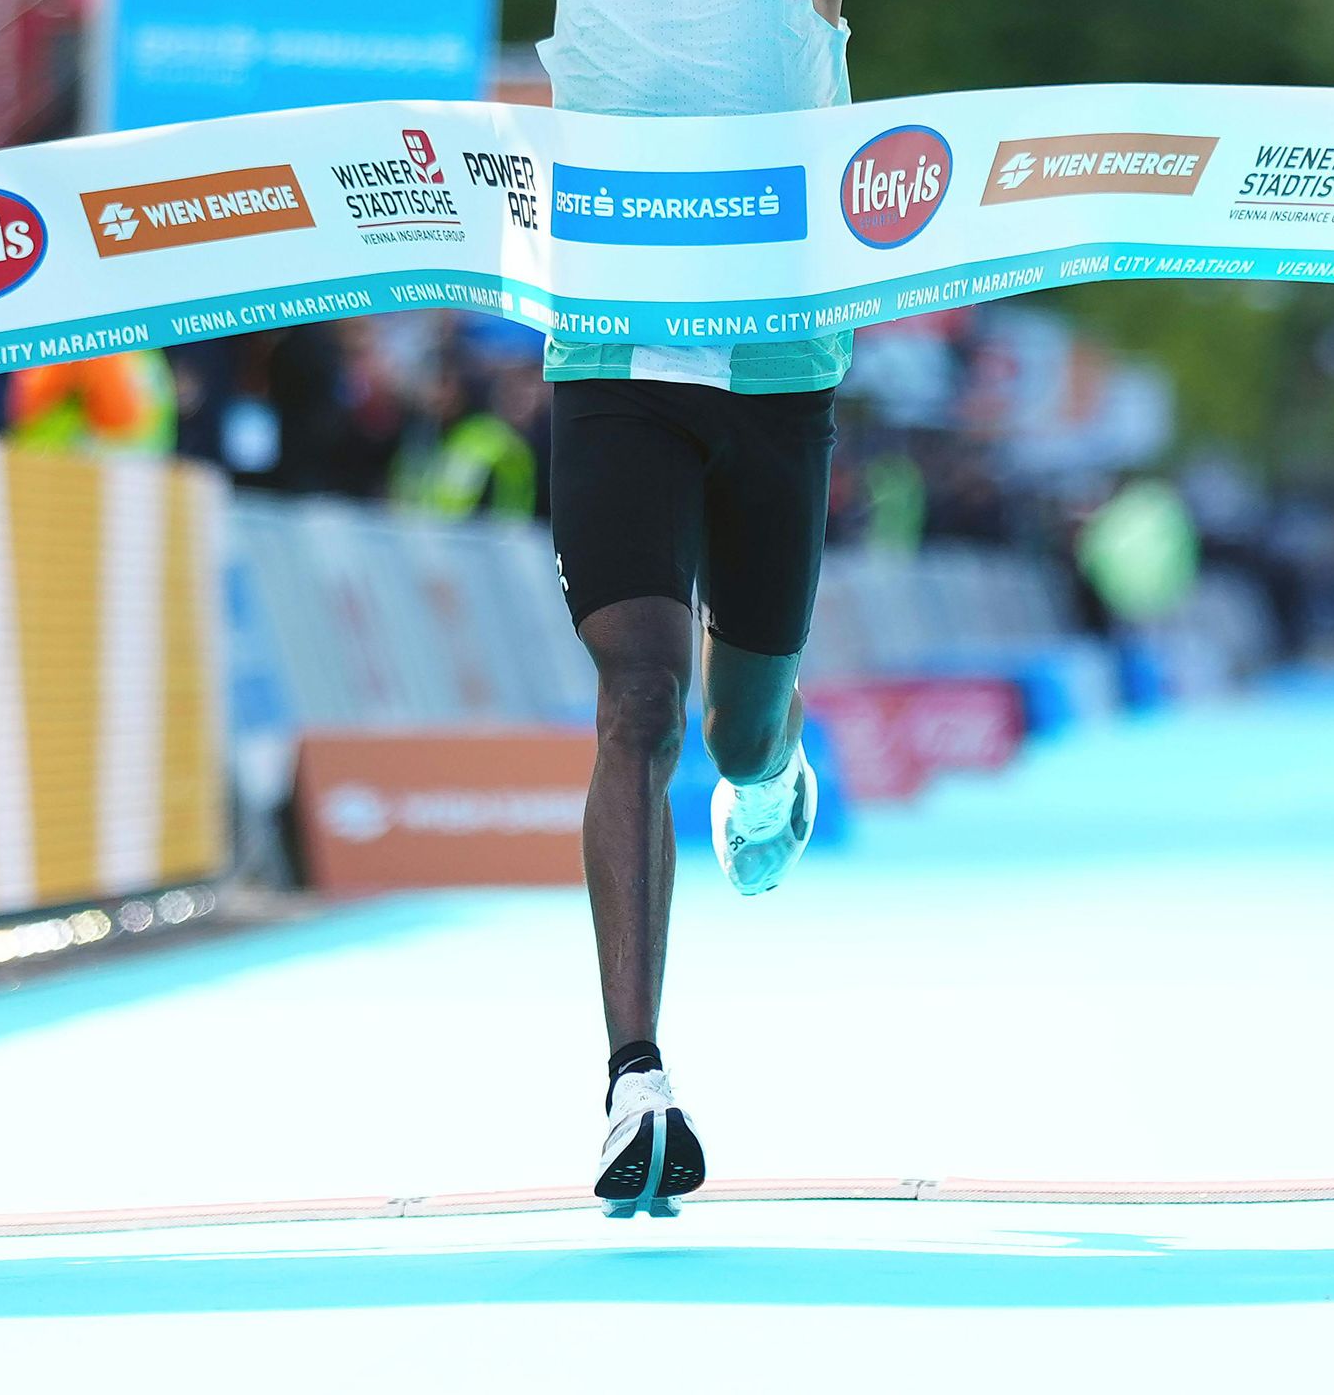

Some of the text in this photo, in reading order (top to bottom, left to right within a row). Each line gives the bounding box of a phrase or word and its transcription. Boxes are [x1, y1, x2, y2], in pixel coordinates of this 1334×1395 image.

[331, 159, 417, 190] WIENER
[462, 152, 536, 190] POWER
[1042, 150, 1200, 179] WIEN ENERGIE
[852, 155, 941, 219] Hervis
[142, 184, 300, 230] WIEN ENERGIE
[346, 189, 458, 219] STÄDTISCHE
[508, 191, 539, 230] ADE
[556, 190, 591, 215] ERSTE
[622, 196, 756, 219] SPARKASSE
[1229, 209, 1267, 221] VIENNA
[1269, 211, 1330, 223] INSURANCE
[361, 230, 466, 245] VIENNA INSURANCE GROUP
[1059, 255, 1254, 279] VIENNA CITY MARATHON
[390, 282, 444, 305] VIENNA
[445, 283, 468, 303] CITY
[469, 286, 513, 312] MARATH
[896, 265, 1044, 311] VIENNA CITY MARATHON
[171, 289, 372, 336] VIENNA CITY MARATHON
[546, 308, 630, 335] RATHON
[666, 297, 882, 337] VIENNA CITY MARATHON
[39, 323, 150, 357] MARATHON
